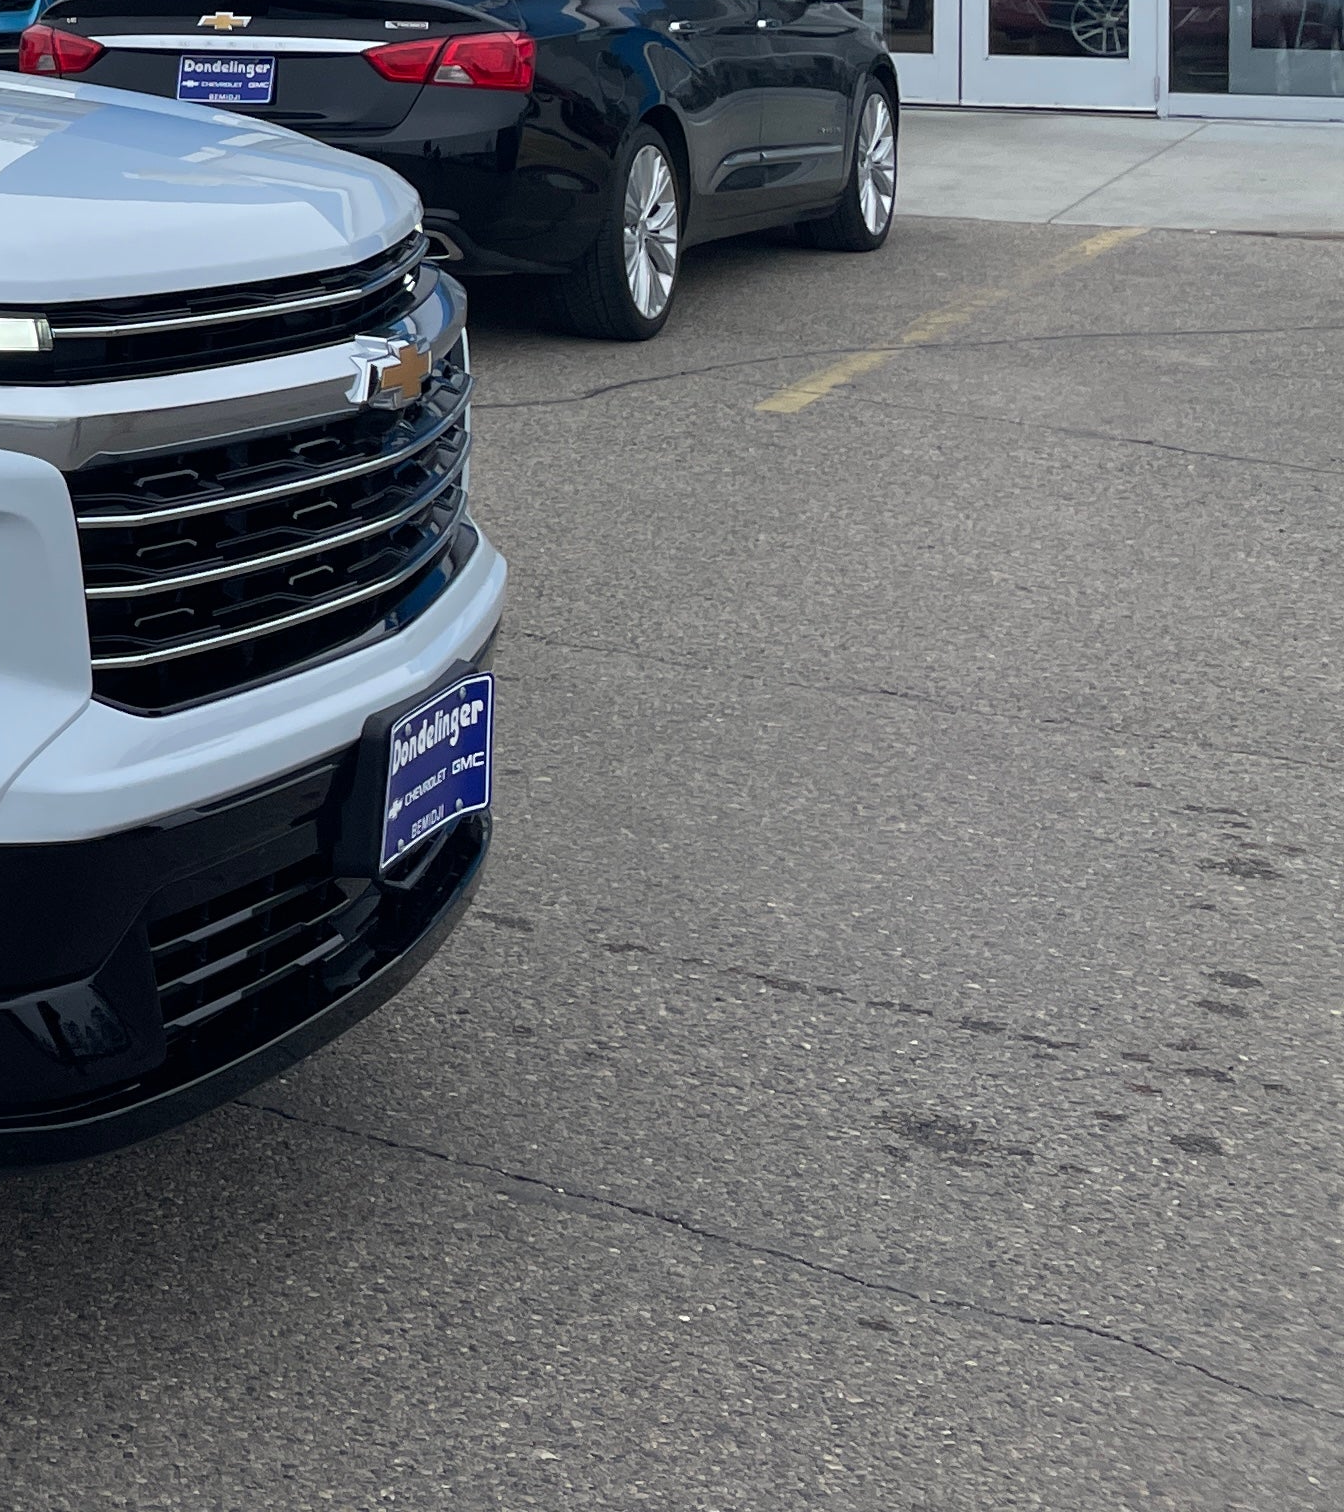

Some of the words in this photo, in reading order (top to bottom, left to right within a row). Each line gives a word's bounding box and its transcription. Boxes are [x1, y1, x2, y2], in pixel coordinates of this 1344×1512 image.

[183, 58, 271, 78] Dondelinger
[247, 81, 270, 89] GMC
[391, 699, 484, 777] Dondelinger
[404, 767, 448, 807] CHEVROLET
[451, 751, 485, 775] GMC
[411, 803, 445, 839] BEMIDJI
